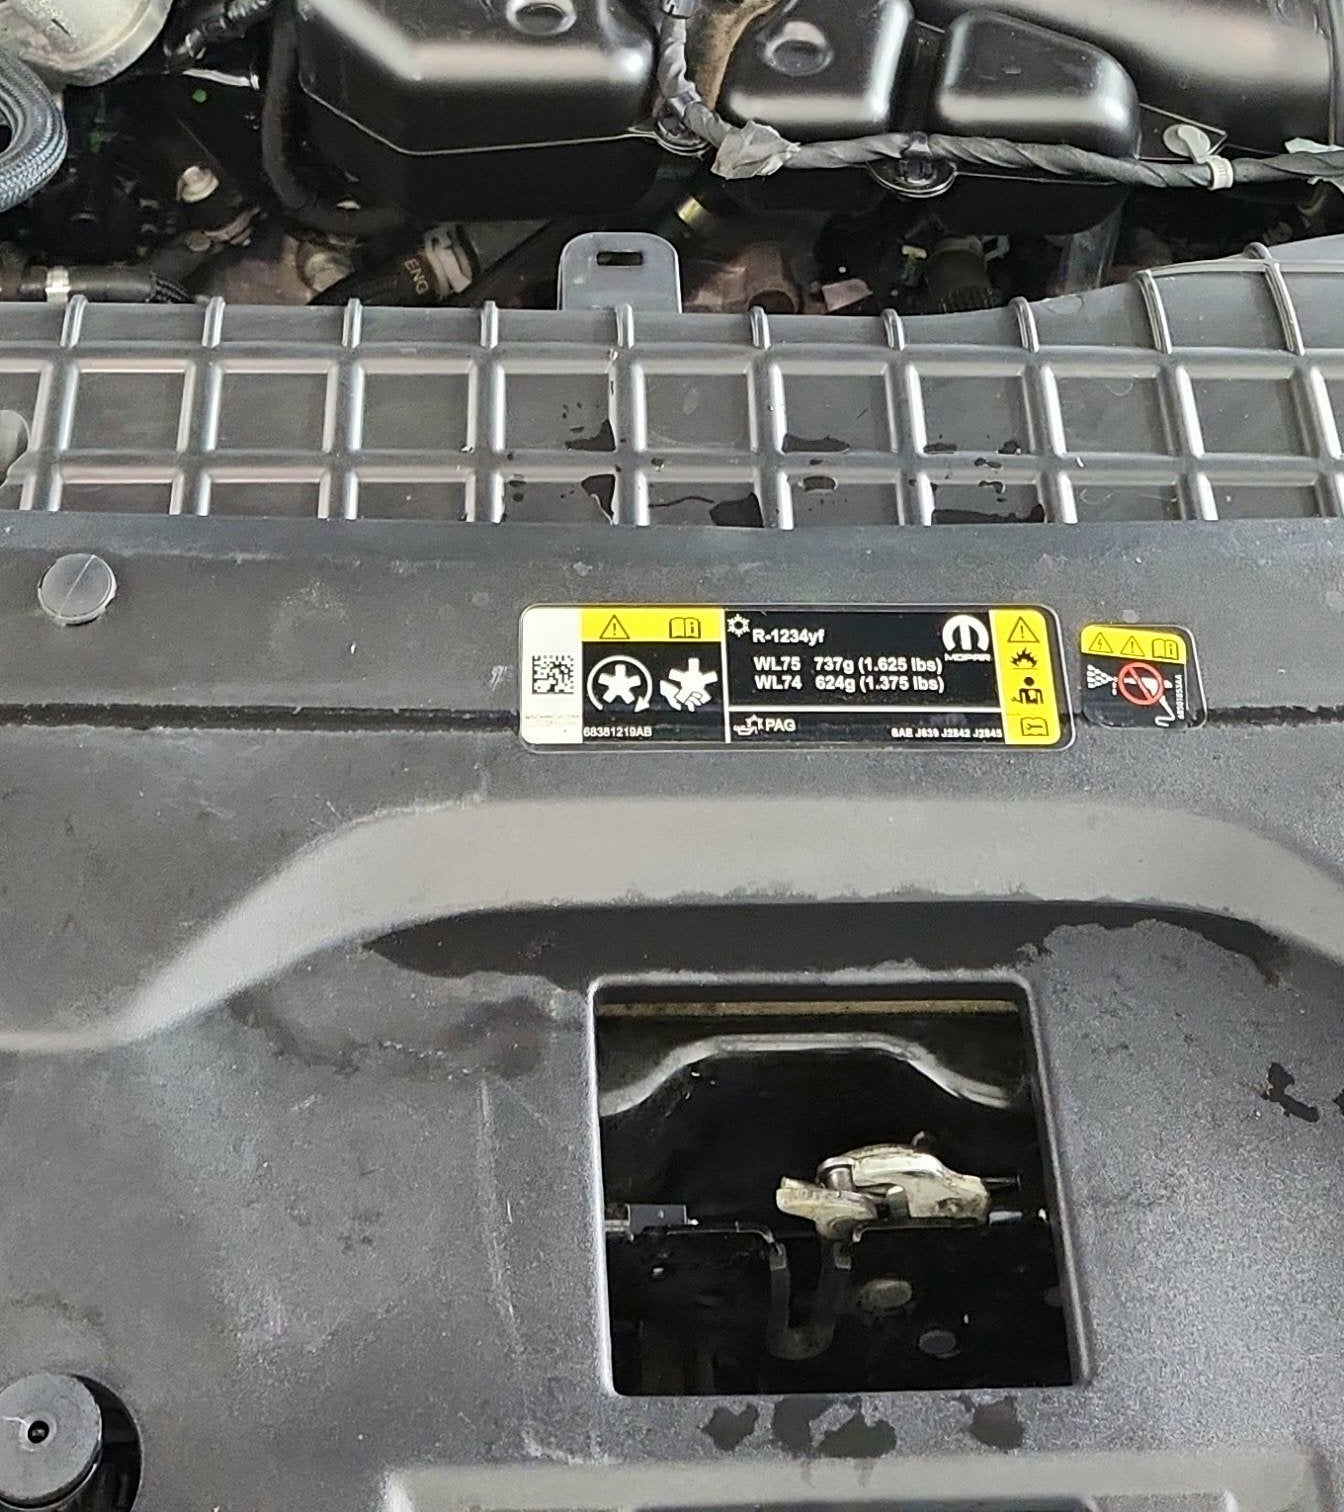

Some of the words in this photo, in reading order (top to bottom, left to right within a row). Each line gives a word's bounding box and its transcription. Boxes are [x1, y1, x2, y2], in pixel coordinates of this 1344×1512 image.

[404, 258, 429, 295] ENG
[752, 629, 825, 646] R-1234yf
[944, 653, 991, 662] MOPAR
[753, 656, 802, 671] WL75
[814, 656, 855, 674] 737g
[858, 656, 906, 674] (1.625
[911, 656, 943, 675] lbs)
[754, 675, 803, 690] WL74
[815, 675, 856, 693] 624g
[859, 675, 909, 693] (1.375
[913, 675, 945, 694] lbs)
[583, 726, 652, 737] 68381219AB
[765, 718, 797, 732] PAG
[891, 728, 913, 738] SAE
